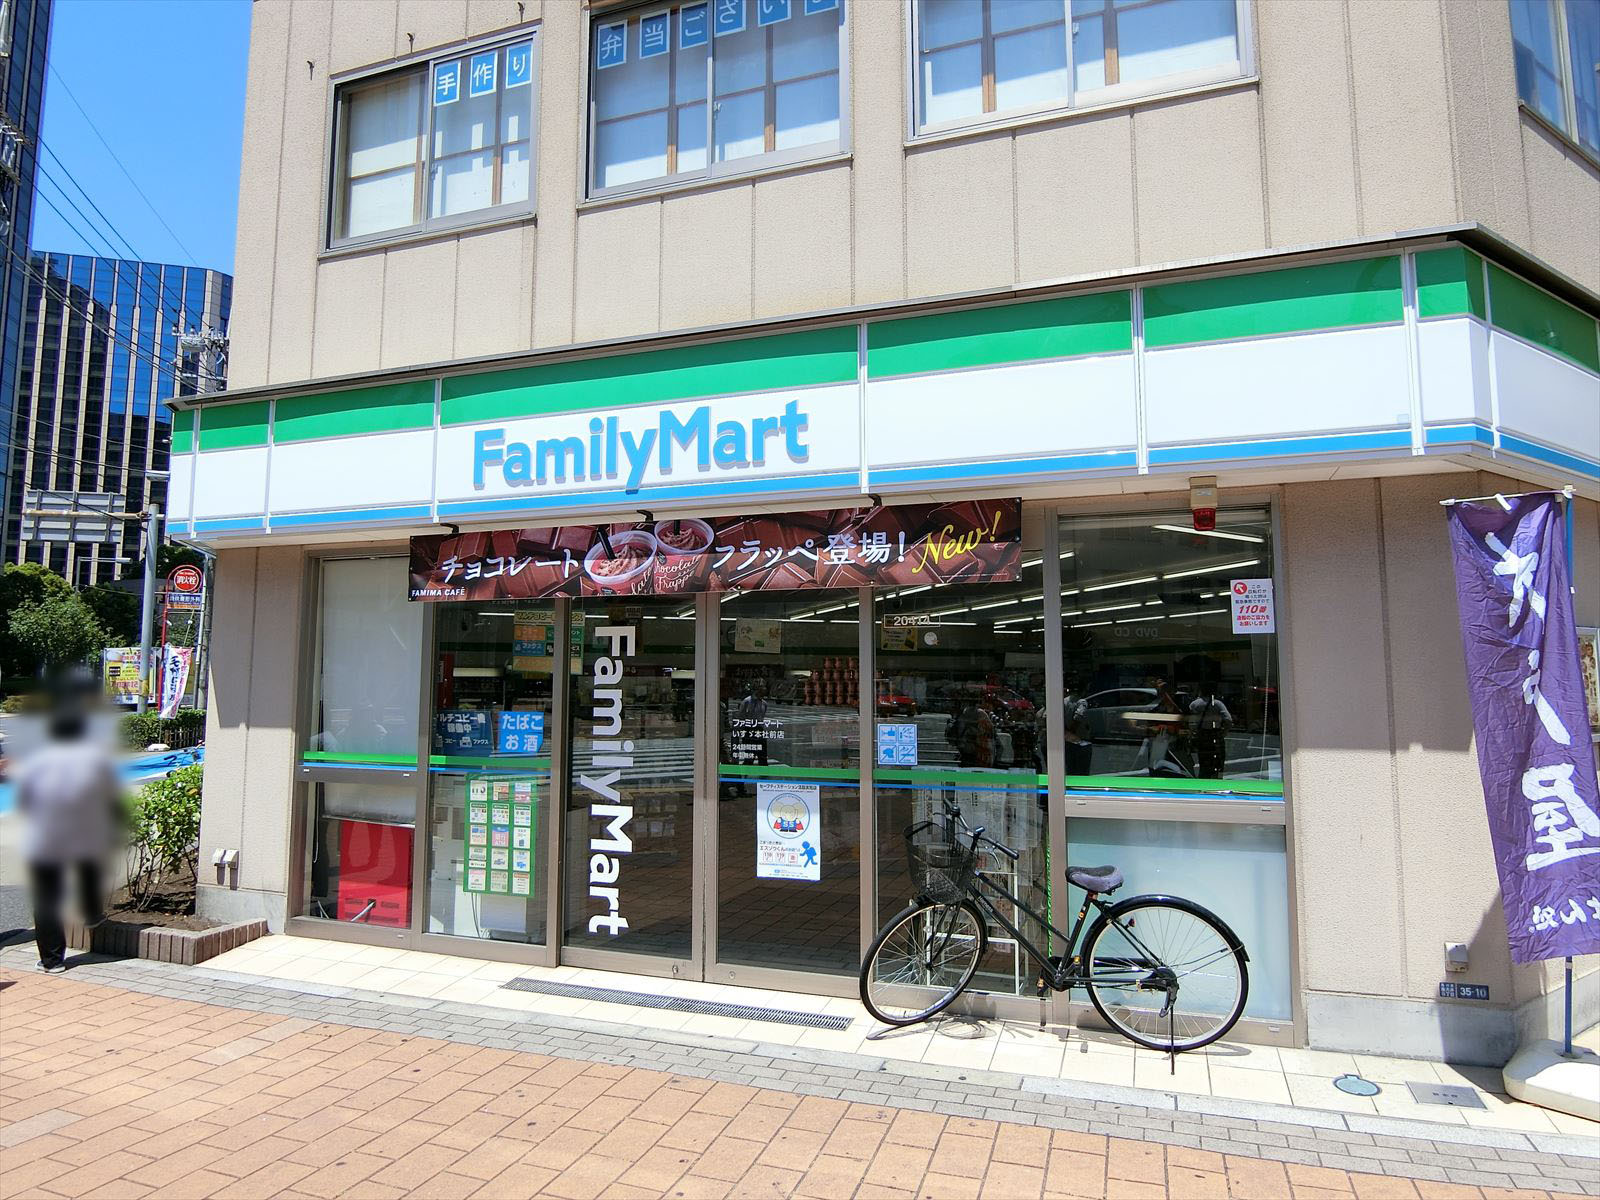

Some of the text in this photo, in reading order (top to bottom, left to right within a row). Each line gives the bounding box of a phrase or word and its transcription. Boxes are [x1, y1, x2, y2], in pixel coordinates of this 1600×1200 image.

[600, 0, 820, 60] 弁当ござい
[436, 53, 528, 97] 手作り
[473, 400, 810, 496] FamilyMart
[911, 511, 1002, 574] New!
[441, 549, 579, 584] チョコレート
[176, 575, 198, 585] 消火栓
[411, 588, 442, 597] FAMIMA
[502, 713, 544, 730] たばこ
[732, 718, 784, 728] ファミリーマート
[505, 734, 539, 752] お酒
[580, 625, 637, 936] FamilyMart
[1459, 986, 1487, 999] 35-10
